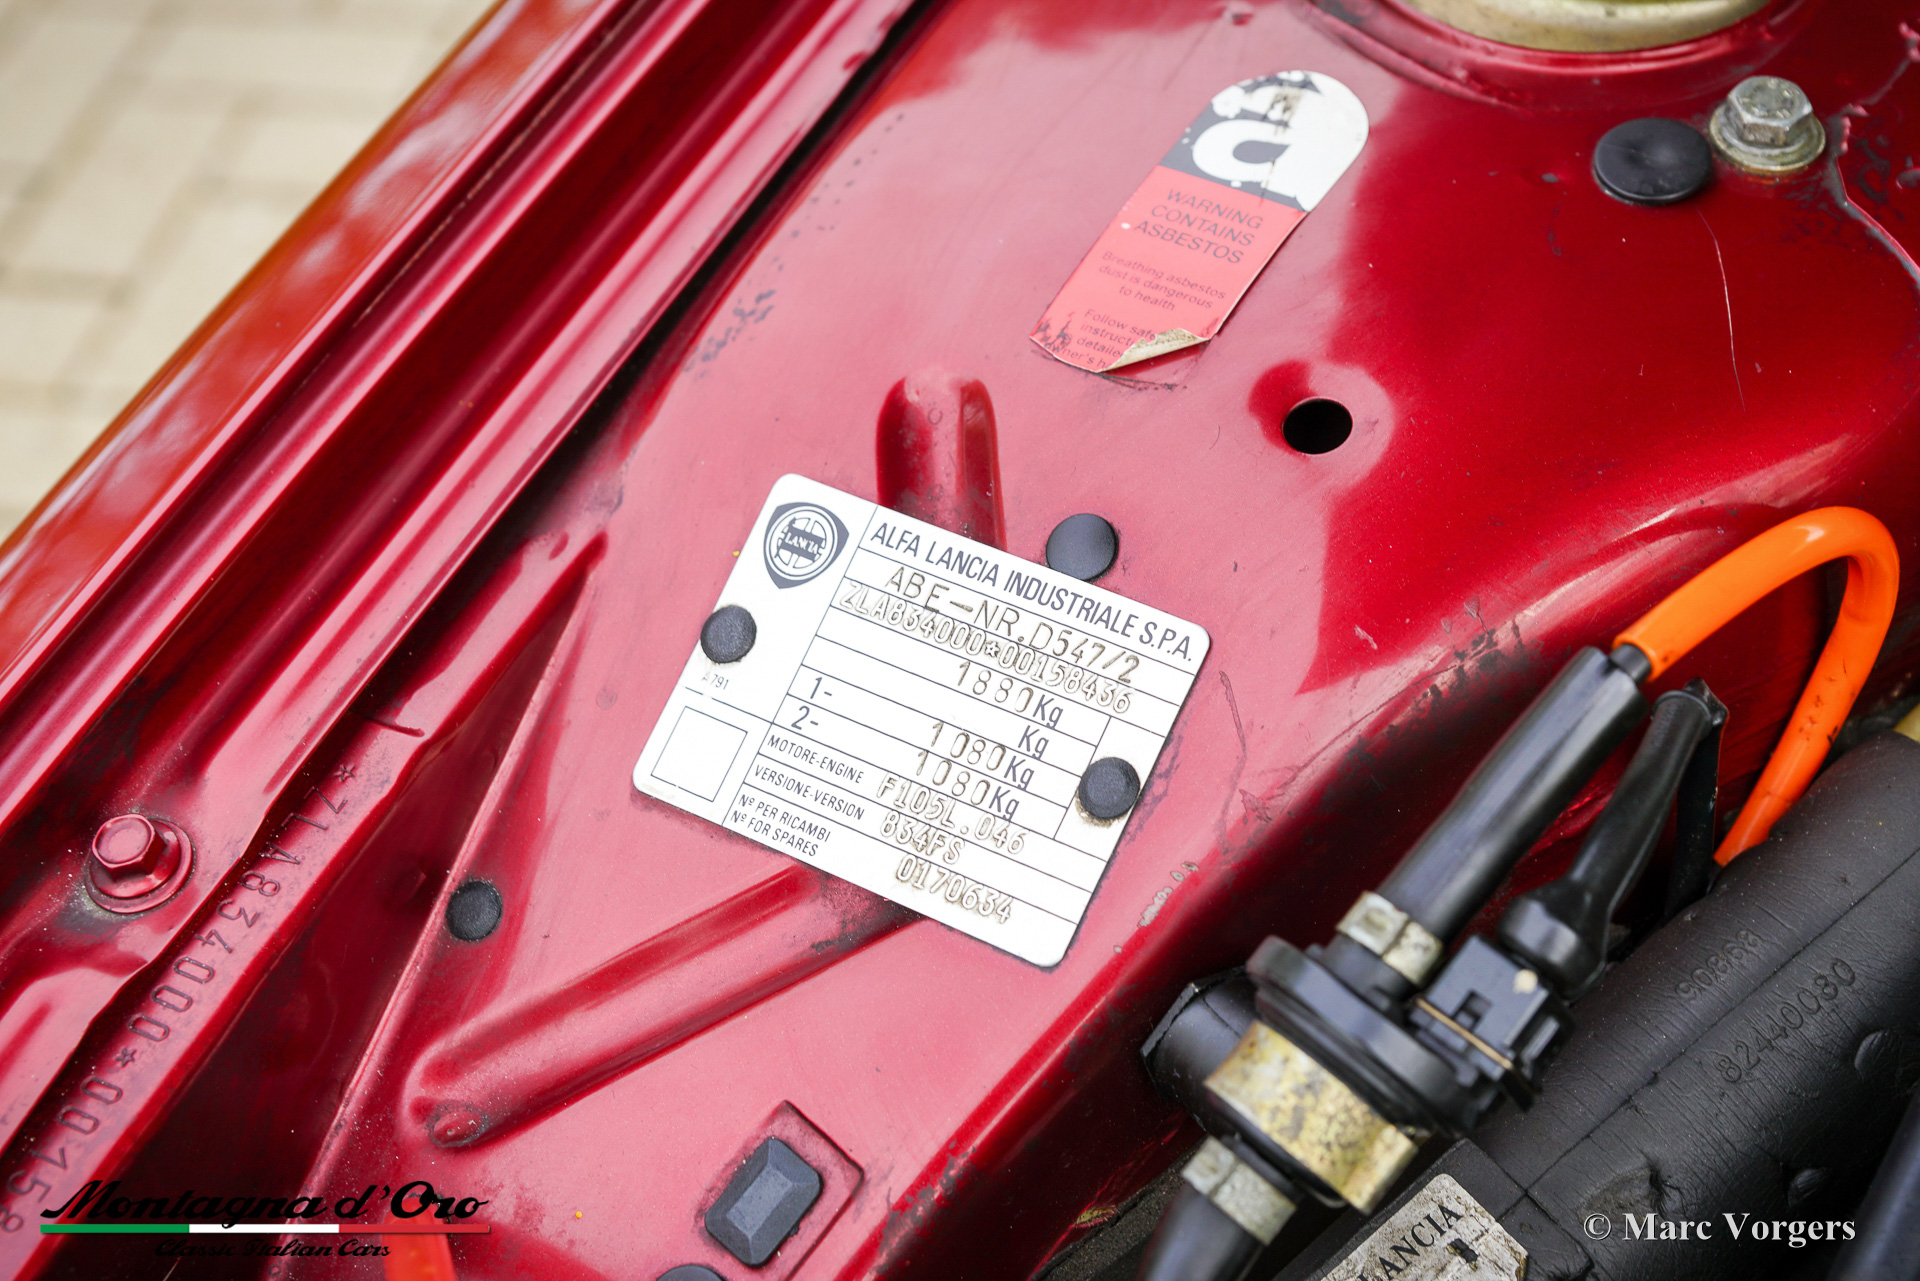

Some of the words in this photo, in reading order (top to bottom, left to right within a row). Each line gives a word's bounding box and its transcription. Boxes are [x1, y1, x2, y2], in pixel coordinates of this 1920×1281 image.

[1151, 204, 1255, 246] CONTAINS
[1168, 189, 1263, 229] WARNING
[1134, 220, 1244, 264] ASBESTOS
[1099, 264, 1127, 281] dust
[1129, 274, 1140, 285] is
[1143, 278, 1214, 309] dangerous
[1102, 251, 1165, 280] Breathing
[1166, 273, 1226, 300] asbestos
[1118, 285, 1133, 297] to
[1134, 290, 1176, 312] health
[1084, 308, 1128, 330] Follow
[870, 522, 921, 558] ALFA
[925, 540, 1000, 588] LANCIA
[1003, 570, 1139, 639] INDUSTRIALE
[1139, 621, 1192, 662] S.P.A.
[959, 660, 1034, 713] 1880
[1032, 693, 1064, 730] Kg
[809, 676, 833, 700] 1-
[930, 720, 1007, 771] 1080
[1003, 755, 1035, 791] Kg
[1017, 724, 1049, 760] Kg
[791, 705, 819, 731] 2-
[916, 749, 991, 806] 1080
[988, 785, 1020, 822] Kg
[754, 764, 865, 821] VERSIONE-VERSION
[879, 809, 966, 865] 834FS
[767, 734, 865, 784] MOTORE-ENGINE
[876, 771, 1028, 855] F105L.046
[747, 816, 772, 837] FOR
[772, 827, 819, 858] SPARES
[756, 801, 779, 820] PER
[781, 810, 832, 843] RICAMBI
[895, 853, 1014, 925] 0170634
[1713, 956, 1857, 1084] 82440080
